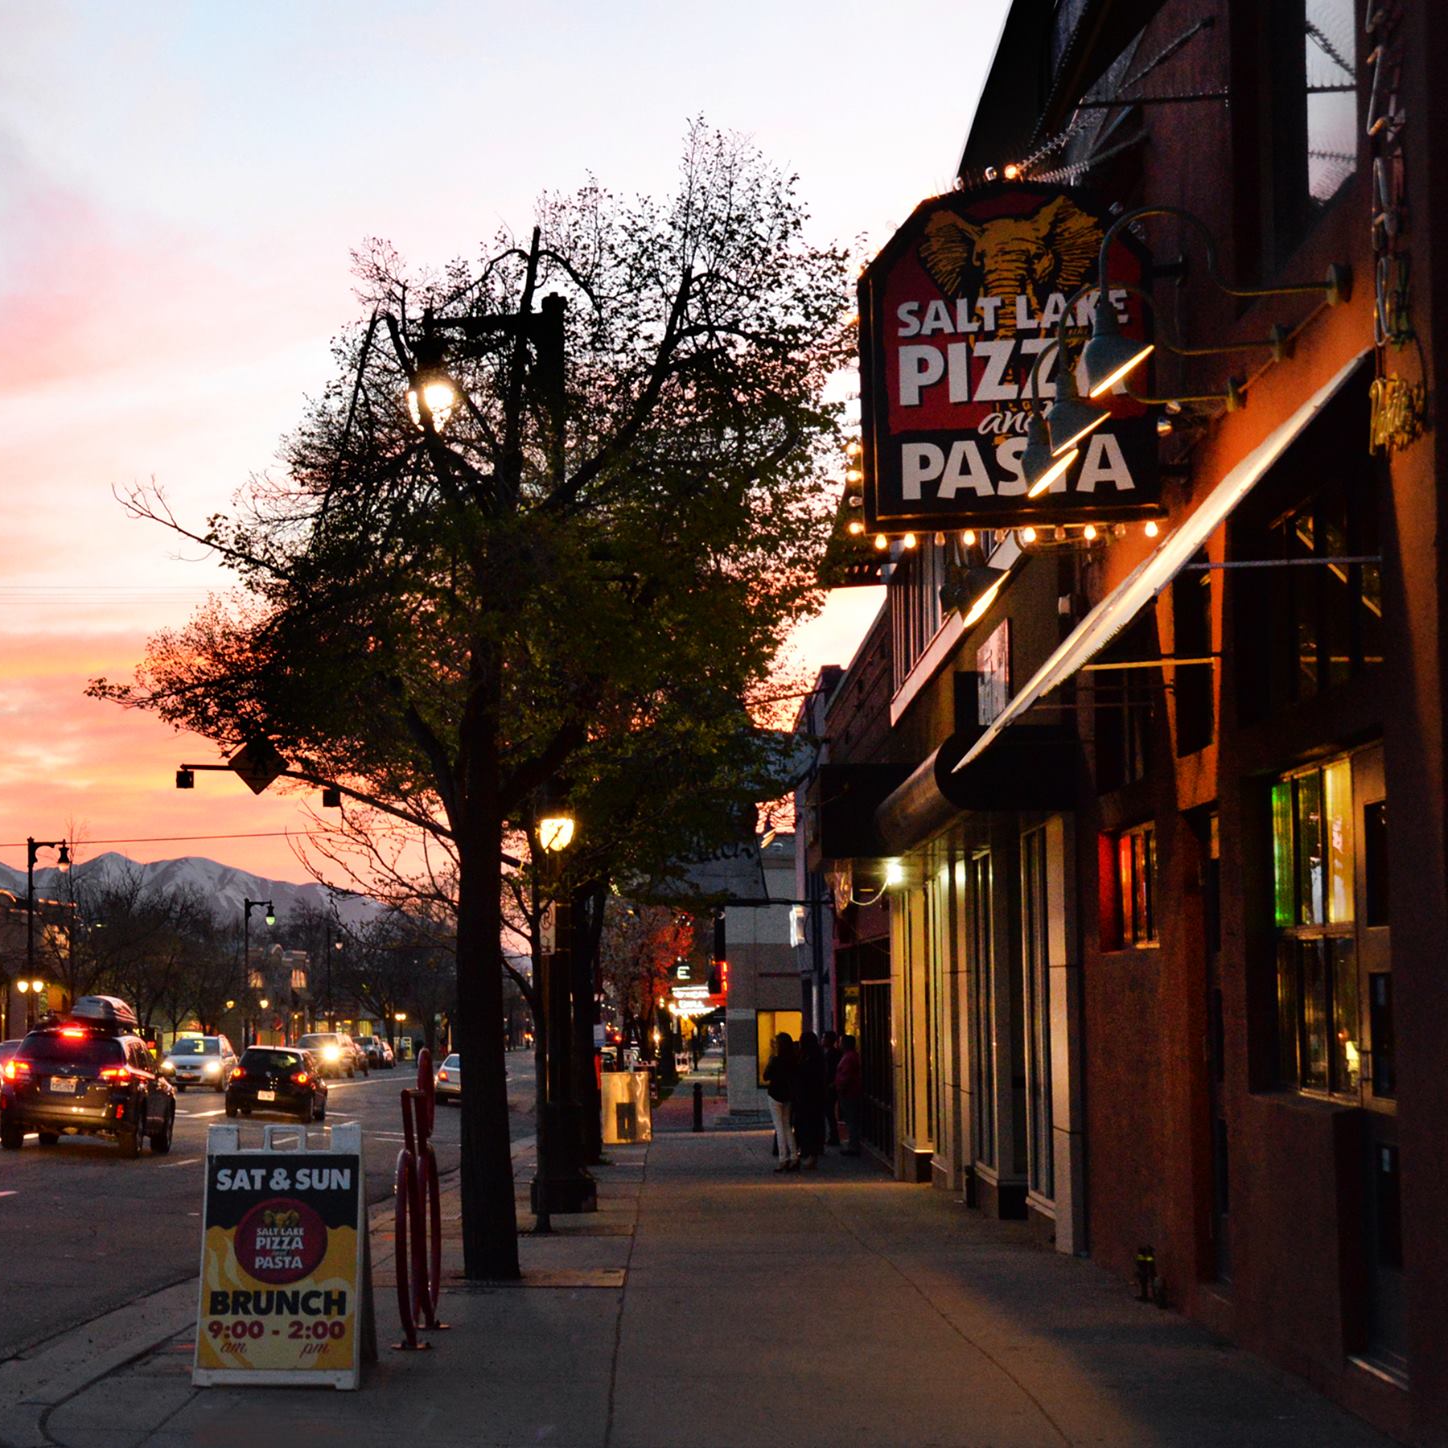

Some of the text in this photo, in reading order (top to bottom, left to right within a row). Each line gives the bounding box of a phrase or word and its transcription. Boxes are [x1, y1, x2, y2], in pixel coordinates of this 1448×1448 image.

[897, 295, 1001, 336] SALT
[902, 433, 1135, 500] PASA
[216, 1168, 351, 1191] SAT & SUN
[255, 1236, 304, 1249] PIZZA
[256, 1228, 304, 1236] SALT LAKE
[255, 1256, 303, 1269] PASTA
[209, 1290, 347, 1316] BRUNCH
[208, 1320, 265, 1339] 9:00
[288, 1320, 345, 1339] 2:00
